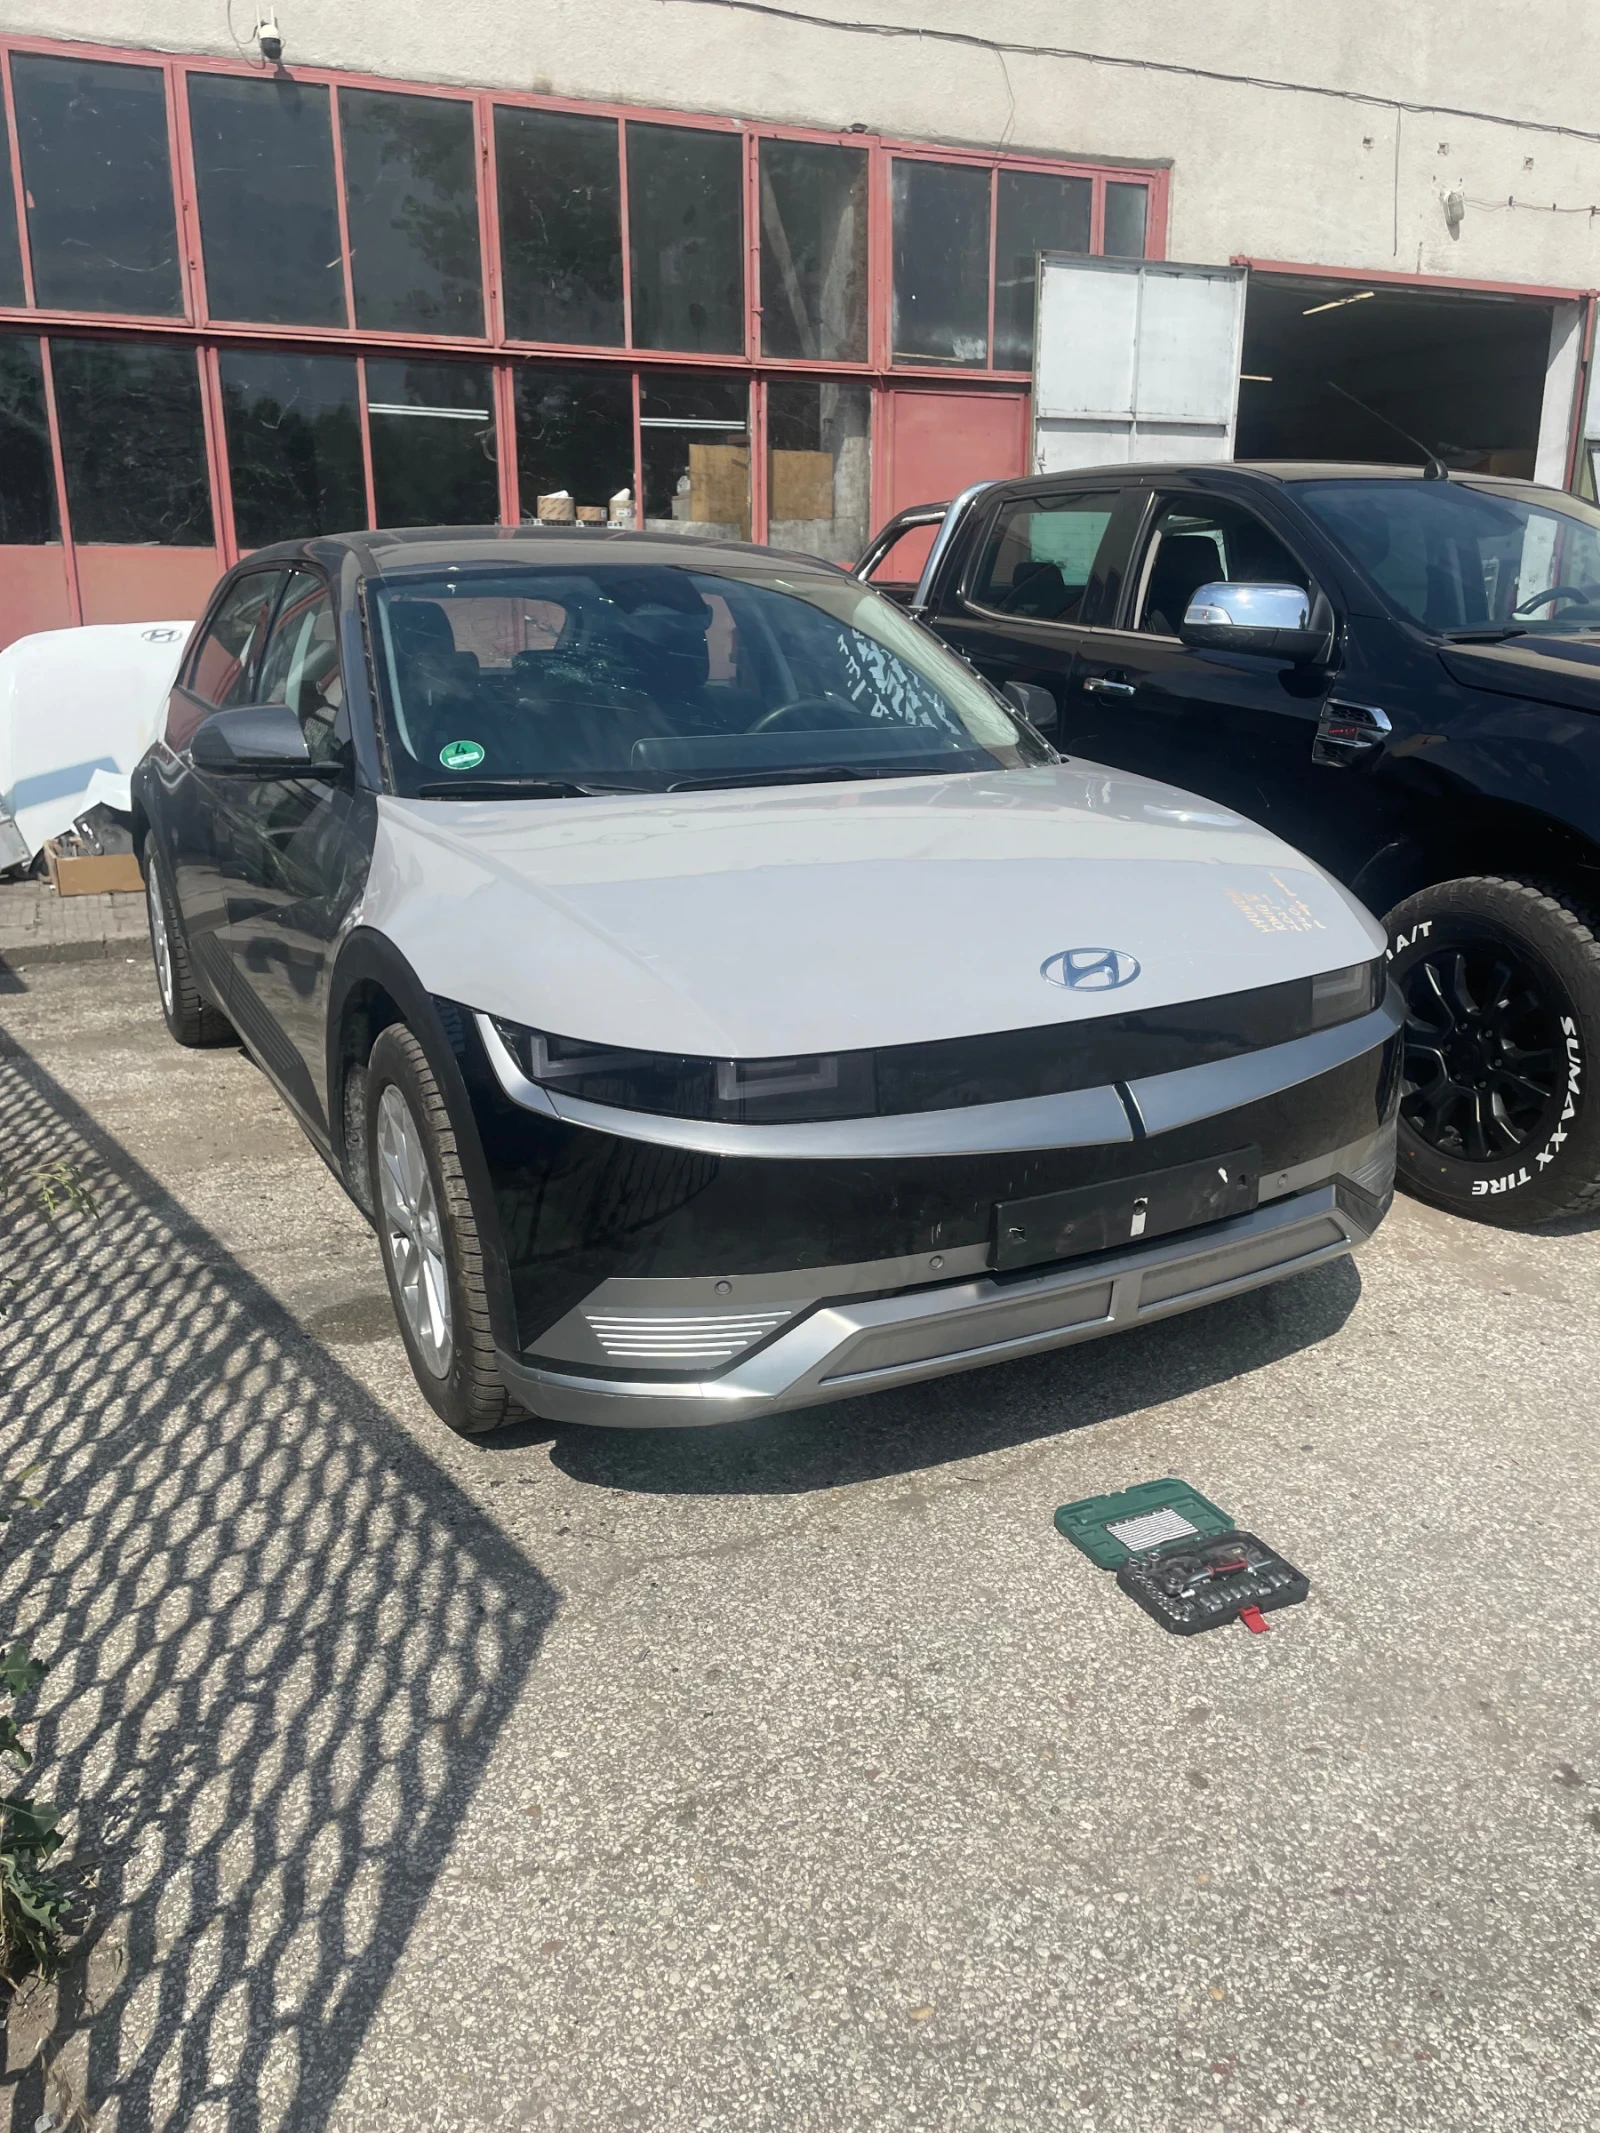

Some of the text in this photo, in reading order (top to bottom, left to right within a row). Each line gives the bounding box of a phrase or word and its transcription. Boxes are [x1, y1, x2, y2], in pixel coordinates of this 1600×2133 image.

[455, 743, 467, 754] 4
[1396, 920, 1432, 954] A/T
[1471, 1167, 1532, 1196] TIRE
